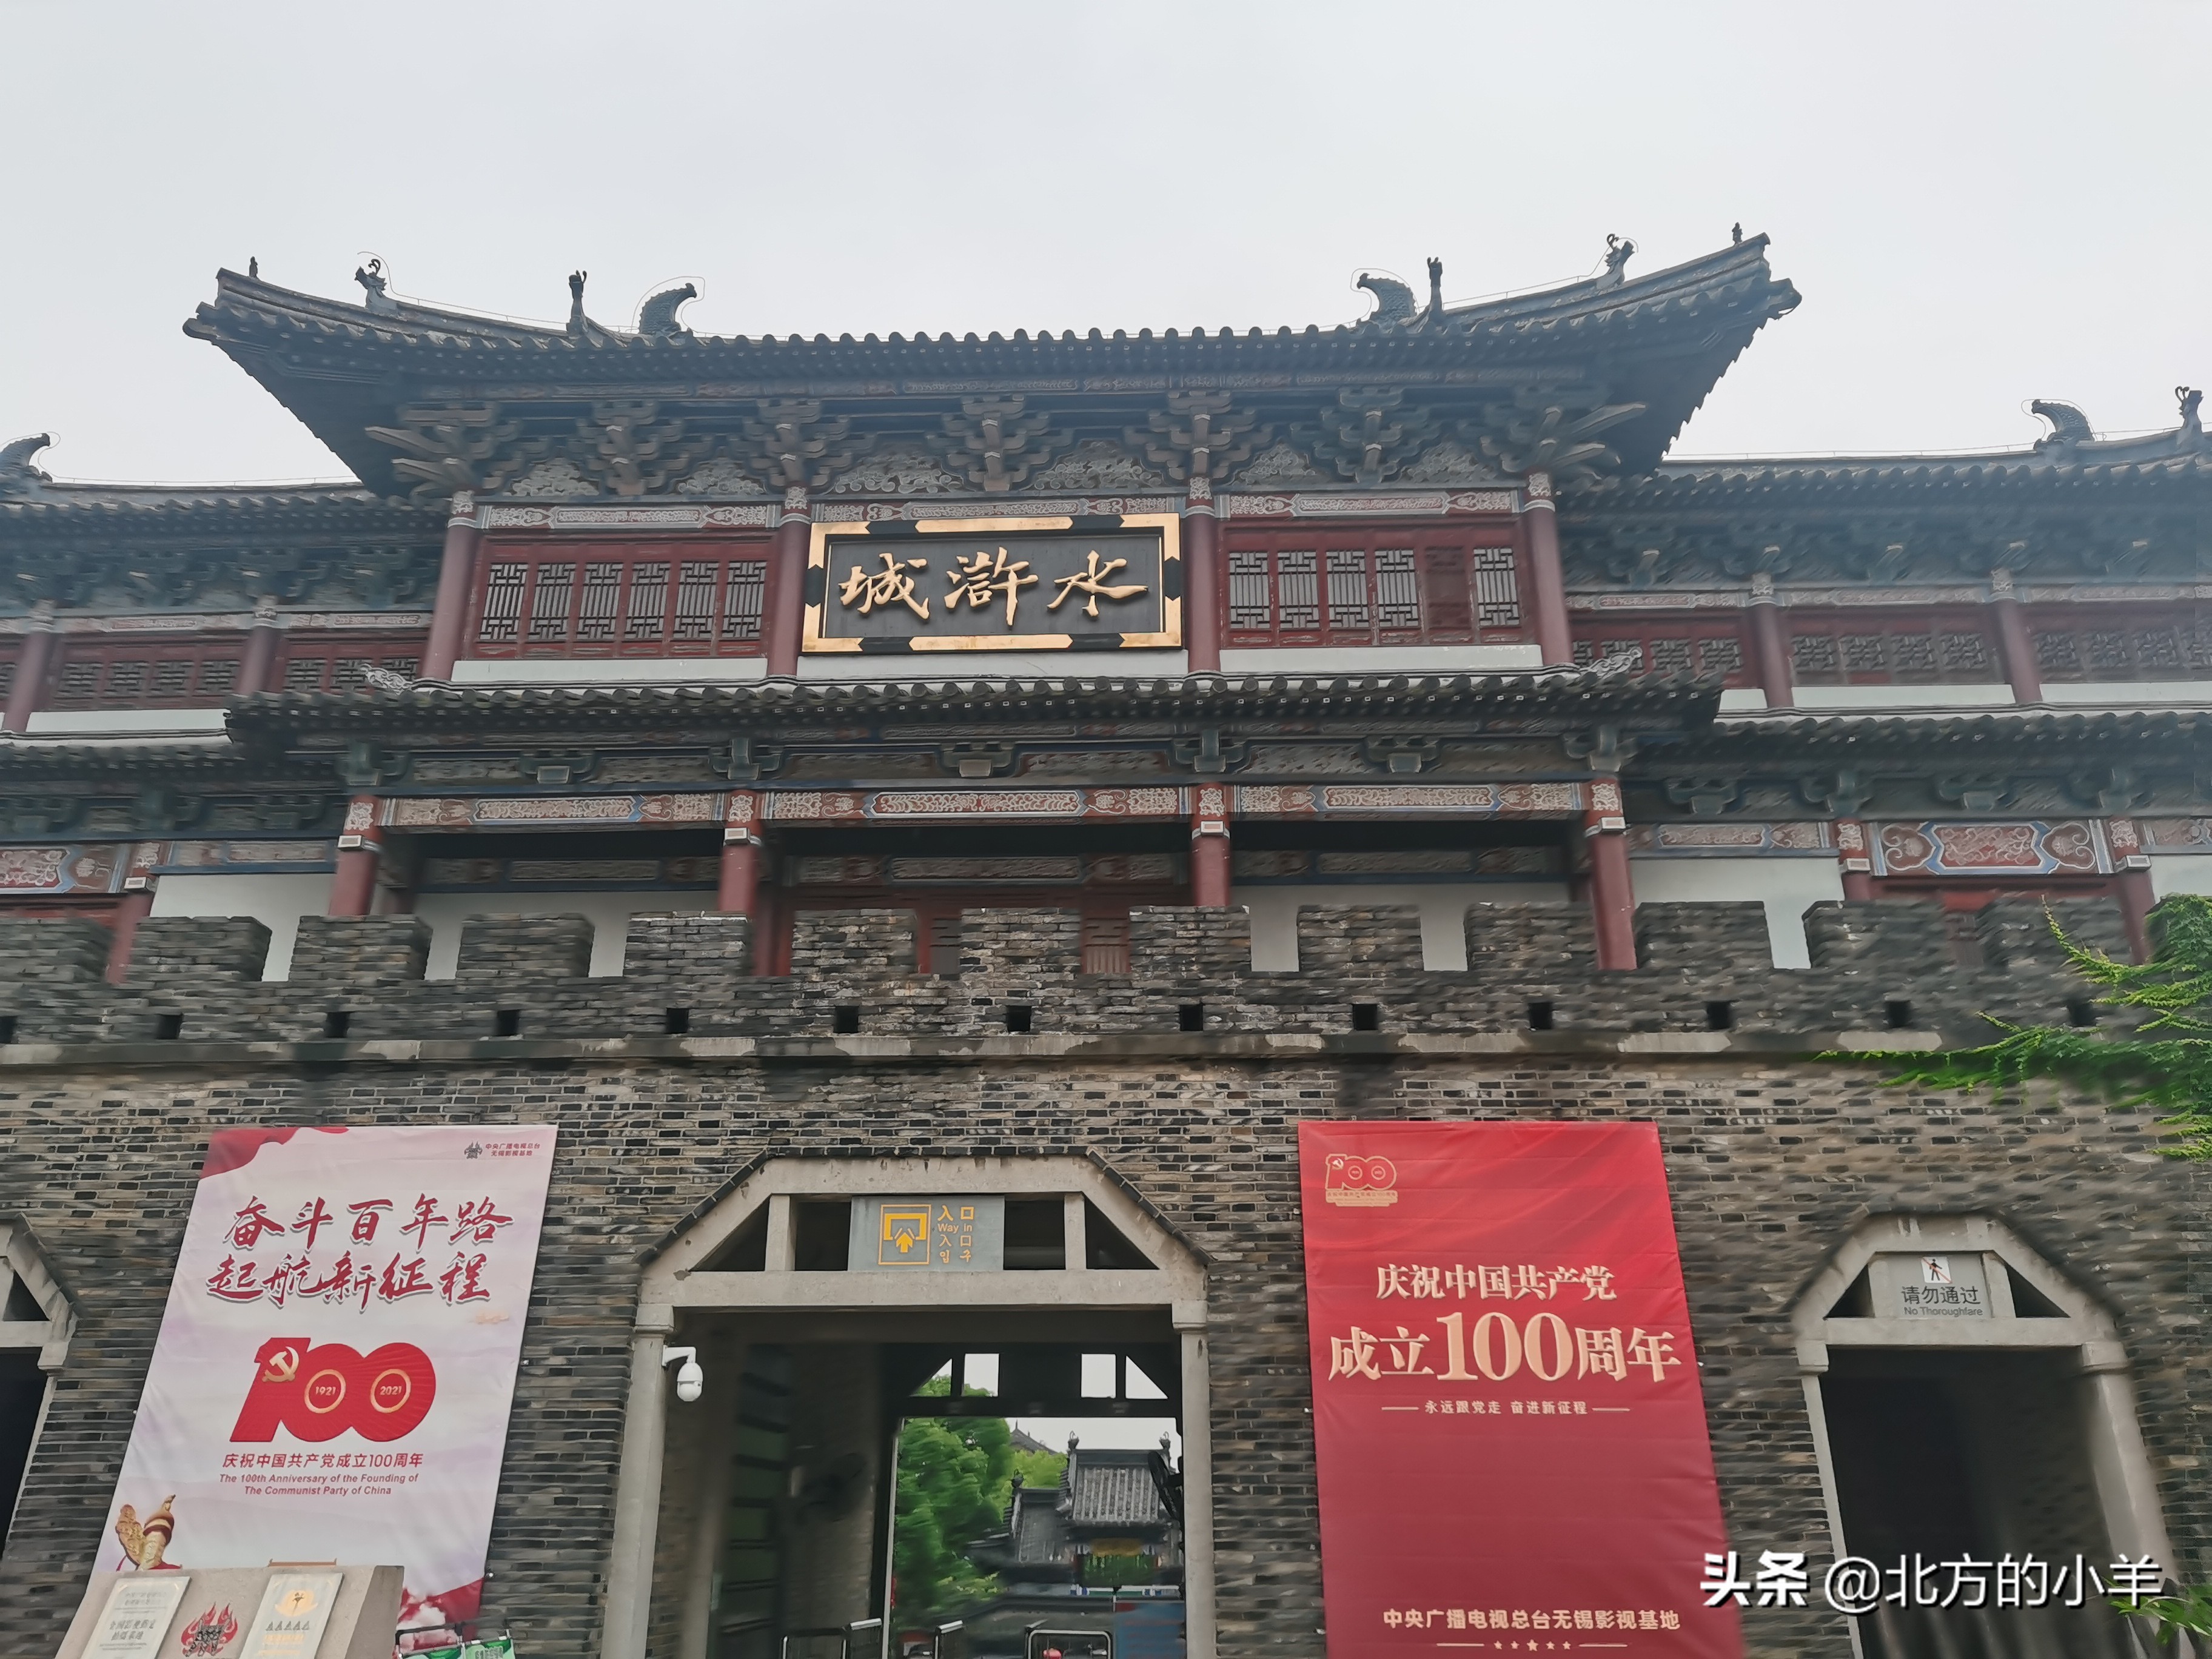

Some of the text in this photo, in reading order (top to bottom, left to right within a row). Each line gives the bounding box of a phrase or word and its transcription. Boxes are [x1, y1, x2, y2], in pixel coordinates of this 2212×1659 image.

[937, 1205, 974, 1221] 入口
[223, 1193, 514, 1251] 奋斗百年路
[938, 1224, 959, 1233] Way
[940, 1250, 971, 1263] 입구
[206, 1253, 491, 1312] 起航新征程
[1376, 1264, 1617, 1301] 庆祝中国共产党
[1902, 1285, 1980, 1304] 请勿通过
[1920, 1307, 1983, 1317] Thoroughfare
[1328, 1312, 1681, 1382] 成立100周年
[315, 1386, 337, 1396] 1921
[380, 1386, 402, 1395] 2021
[1425, 1400, 1587, 1415] 永远跟党走 奋进新征程
[223, 1453, 423, 1468] 庆祝中国共产党成立100周年
[220, 1473, 419, 1485] The 100th Anniversary of the Founding of
[244, 1486, 391, 1496] The Communist Party of China
[1383, 1609, 1680, 1630] 中央广播电视总台无锡影视基地
